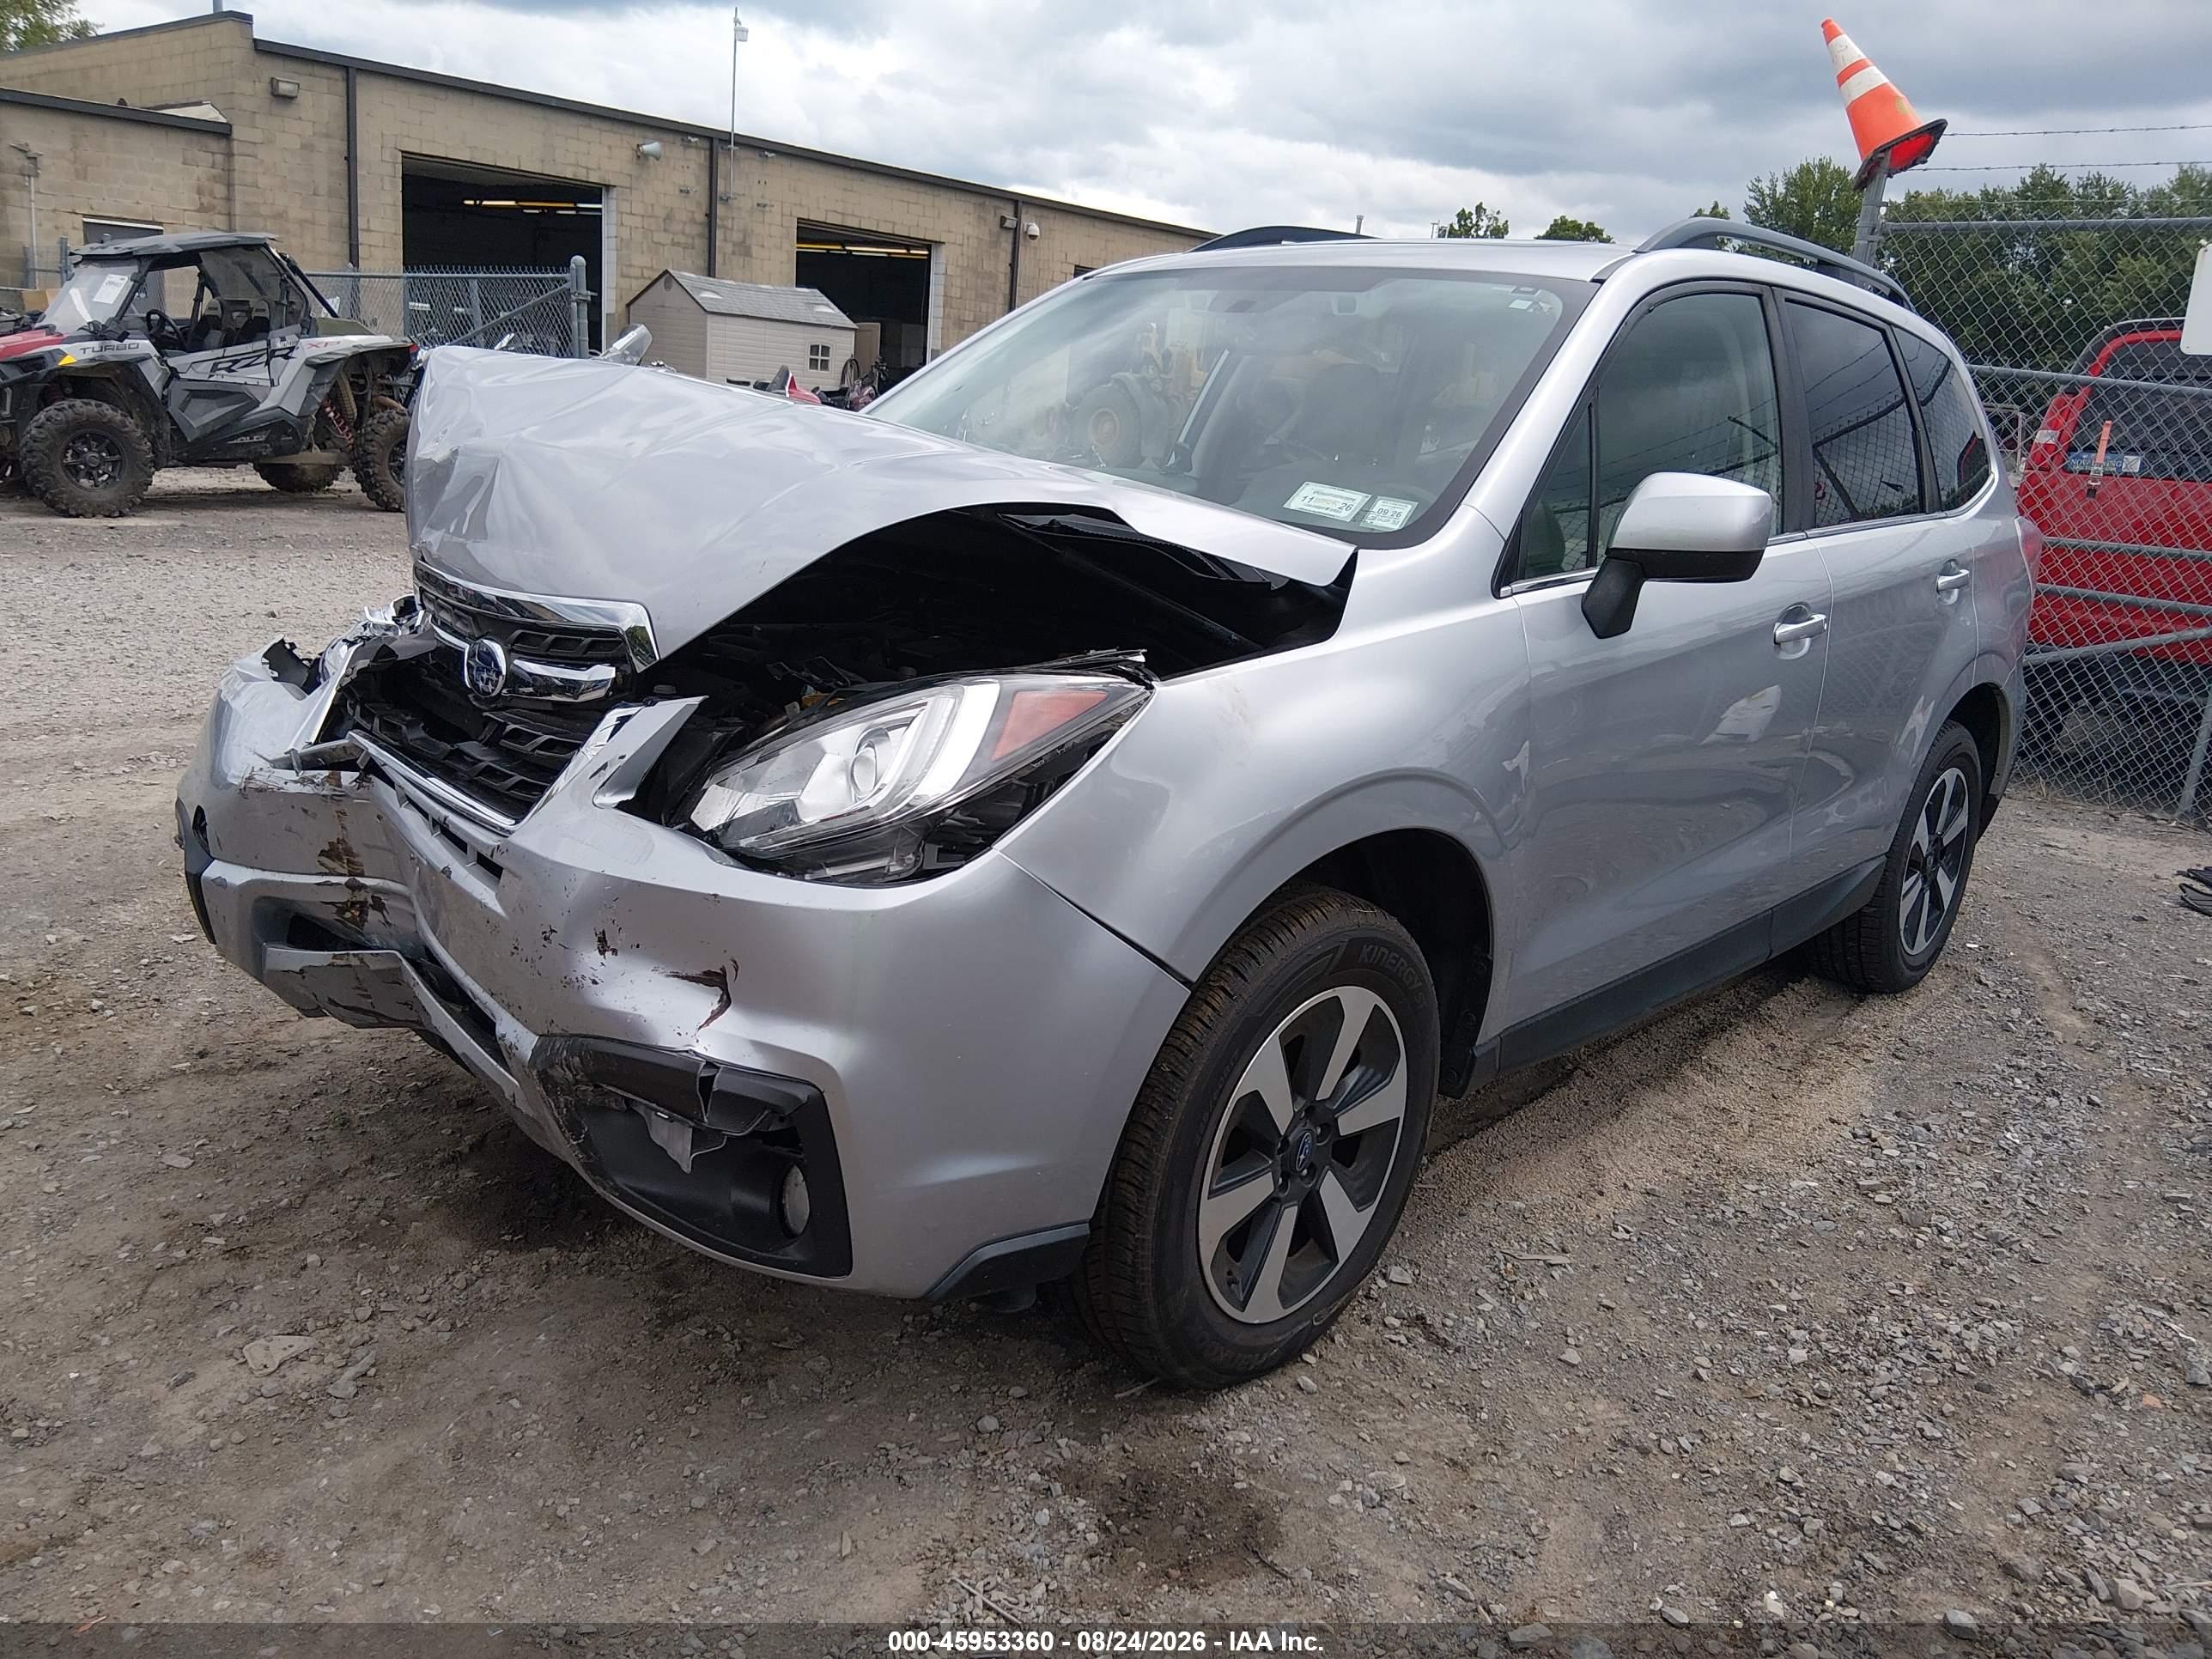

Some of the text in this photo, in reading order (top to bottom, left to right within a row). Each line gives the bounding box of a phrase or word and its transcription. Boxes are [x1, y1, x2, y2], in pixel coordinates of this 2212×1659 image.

[80, 343, 139, 354] TURBO
[208, 345, 296, 378] RZR
[1337, 502, 1354, 512] 26
[1377, 507, 1389, 516] 09
